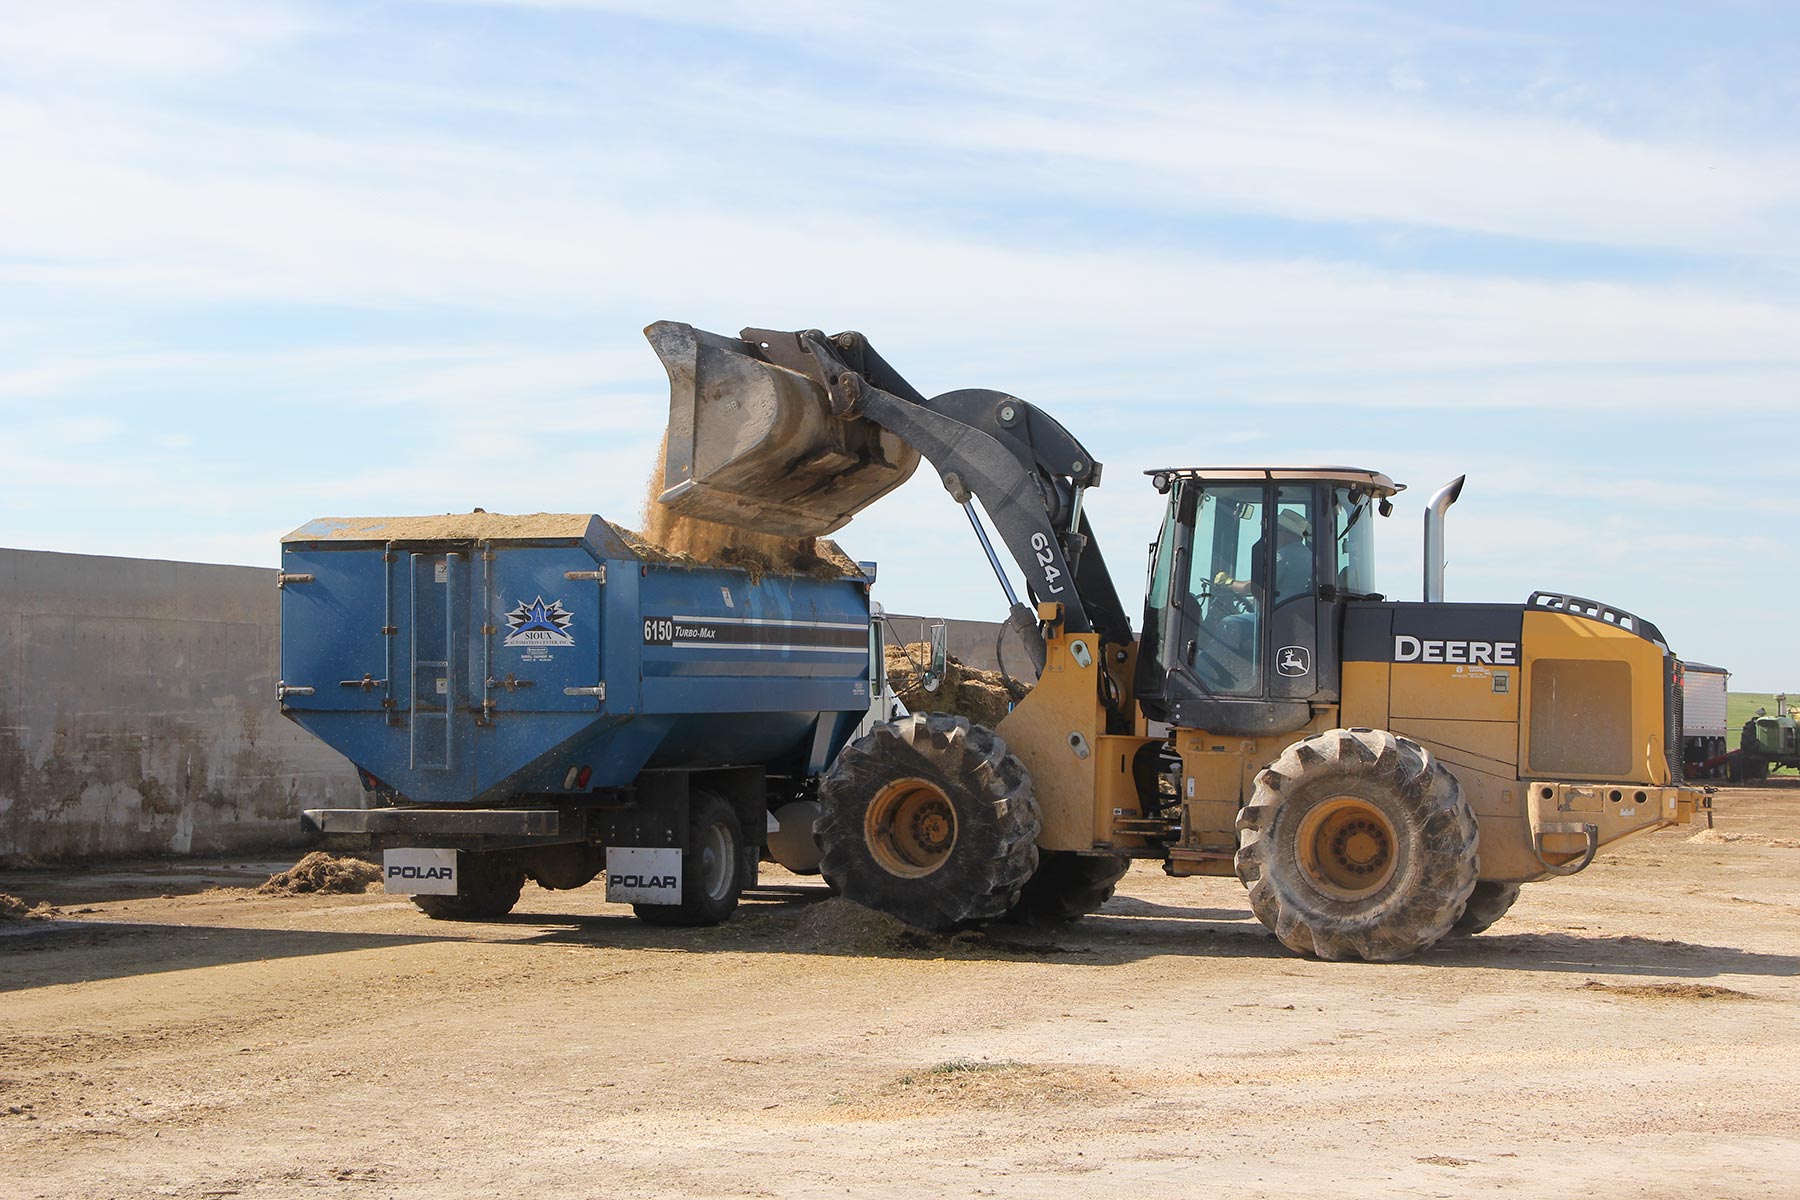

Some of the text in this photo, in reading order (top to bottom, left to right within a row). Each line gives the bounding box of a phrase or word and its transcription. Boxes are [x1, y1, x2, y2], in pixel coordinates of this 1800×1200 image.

[1031, 532, 1064, 594] 624J
[525, 607, 554, 623] SAC
[525, 632, 552, 640] SIOUX
[644, 620, 672, 641] 6150
[1395, 635, 1516, 664] DEERE
[388, 866, 453, 880] POLAR
[609, 875, 677, 889] POLAR
